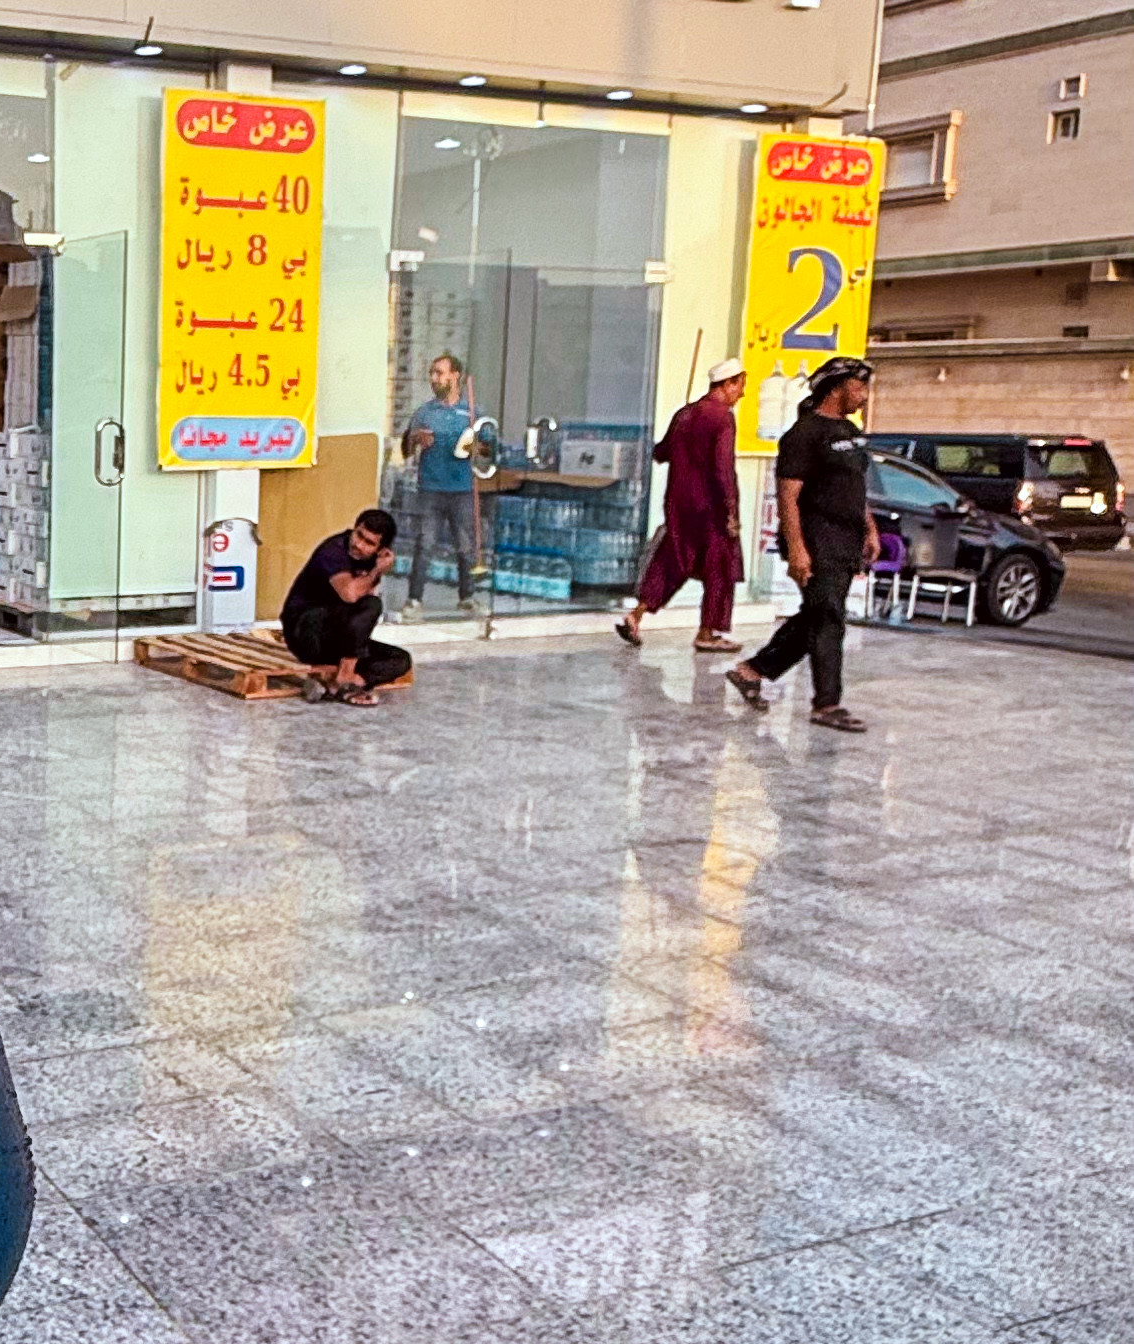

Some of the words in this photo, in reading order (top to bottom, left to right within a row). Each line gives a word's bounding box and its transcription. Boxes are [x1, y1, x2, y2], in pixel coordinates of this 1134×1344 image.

[183, 105, 238, 139] خاص
[249, 110, 309, 147] عرض
[771, 146, 814, 177] خاص
[820, 149, 870, 181] عرض
[179, 176, 268, 219] عبوة
[272, 174, 310, 216] 40
[177, 238, 233, 272] ريال
[247, 234, 268, 266] 8
[269, 297, 306, 333] 24
[780, 247, 843, 352] 2
[174, 300, 258, 338] عبوة
[175, 359, 218, 395] ريال
[227, 353, 271, 387] 4.5
[238, 425, 295, 455] تبريد
